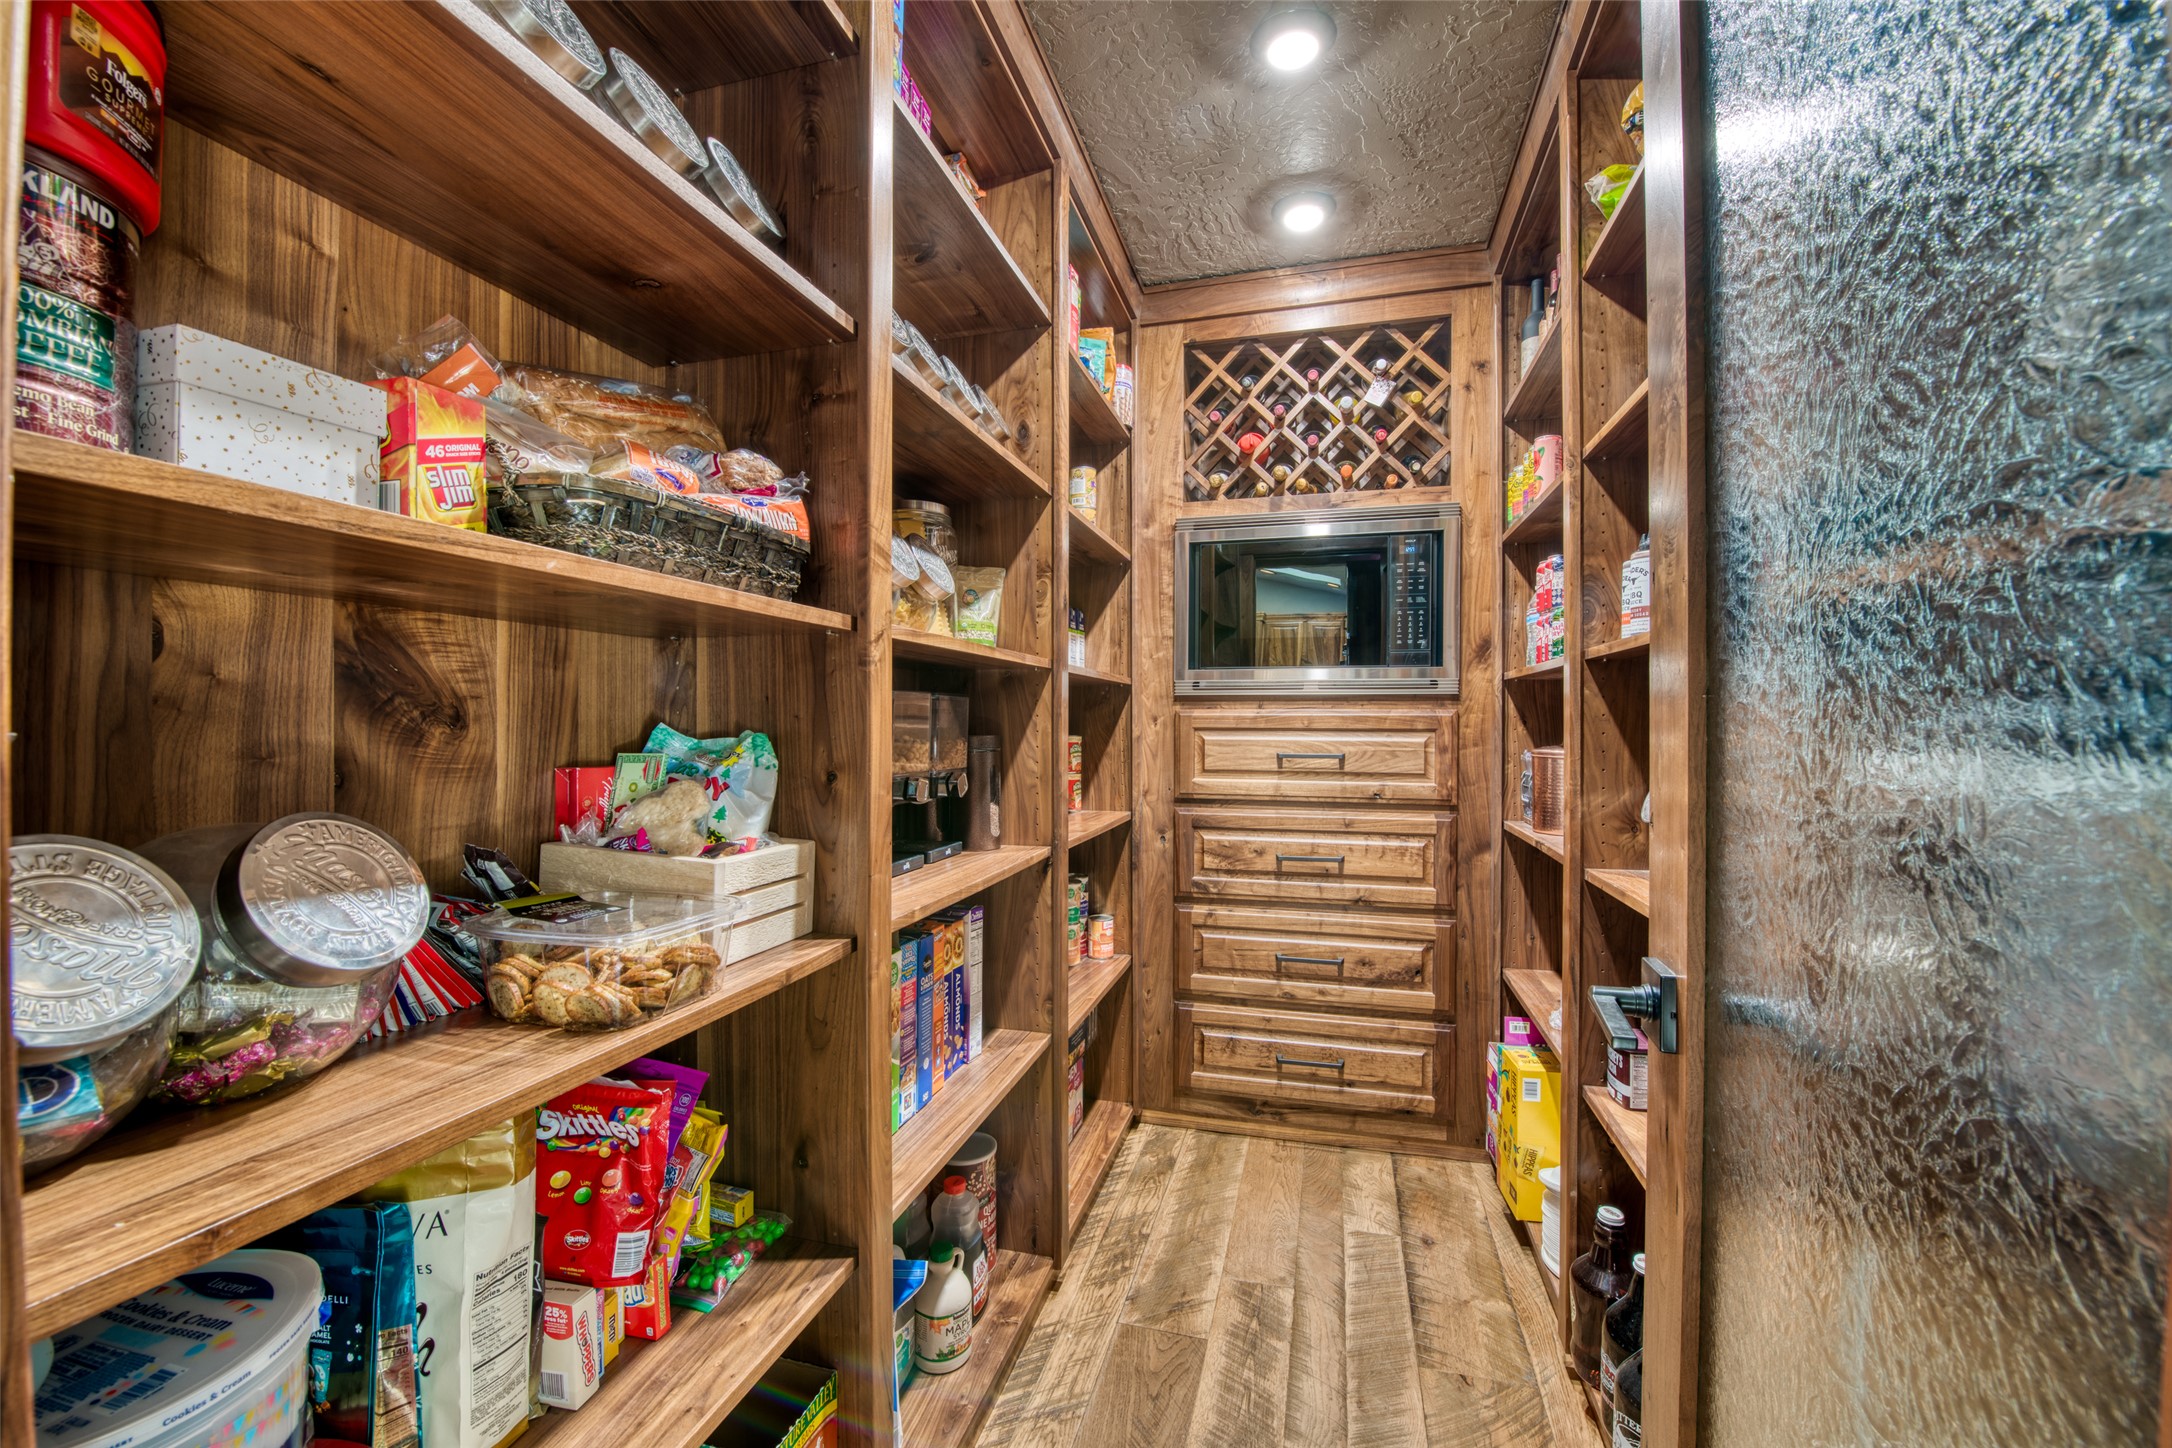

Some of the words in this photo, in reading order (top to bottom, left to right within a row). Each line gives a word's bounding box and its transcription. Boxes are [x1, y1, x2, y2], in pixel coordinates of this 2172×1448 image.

[85, 65, 156, 136] GOURMET
[106, 57, 148, 110] Folgers
[103, 92, 149, 136] SUPREME
[15, 329, 102, 378] FFEE
[56, 394, 96, 417] Bean
[47, 411, 84, 433] Fine
[86, 422, 120, 447] Grind
[425, 444, 445, 459] 46
[445, 443, 481, 452] ORIGINAL
[426, 464, 471, 489] slim
[438, 485, 477, 511] jim
[83, 858, 175, 946] VINTAGE
[920, 973, 934, 986] OATS
[955, 973, 964, 1031] ALMONDS
[536, 1109, 640, 1148] Skittles
[1523, 1147, 1538, 1177] HIPPEAS
[566, 1235, 590, 1246] Skittles
[475, 1257, 509, 1282] Nutrition
[509, 1244, 530, 1260] Facts
[116, 1298, 174, 1320] Cookies
[168, 1310, 191, 1323] &
[183, 1314, 233, 1331] Cream
[472, 1288, 501, 1307] Calories
[545, 1305, 568, 1319] 25%
[132, 1320, 167, 1334] DAIRY
[162, 1326, 214, 1341] DESSERT
[391, 1346, 409, 1357] 140
[577, 1314, 597, 1384] WHOPPERS
[162, 1399, 208, 1427] Cookies
[209, 1392, 219, 1402] &
[220, 1370, 252, 1395] Cream
[806, 1376, 836, 1419] VALLEY
